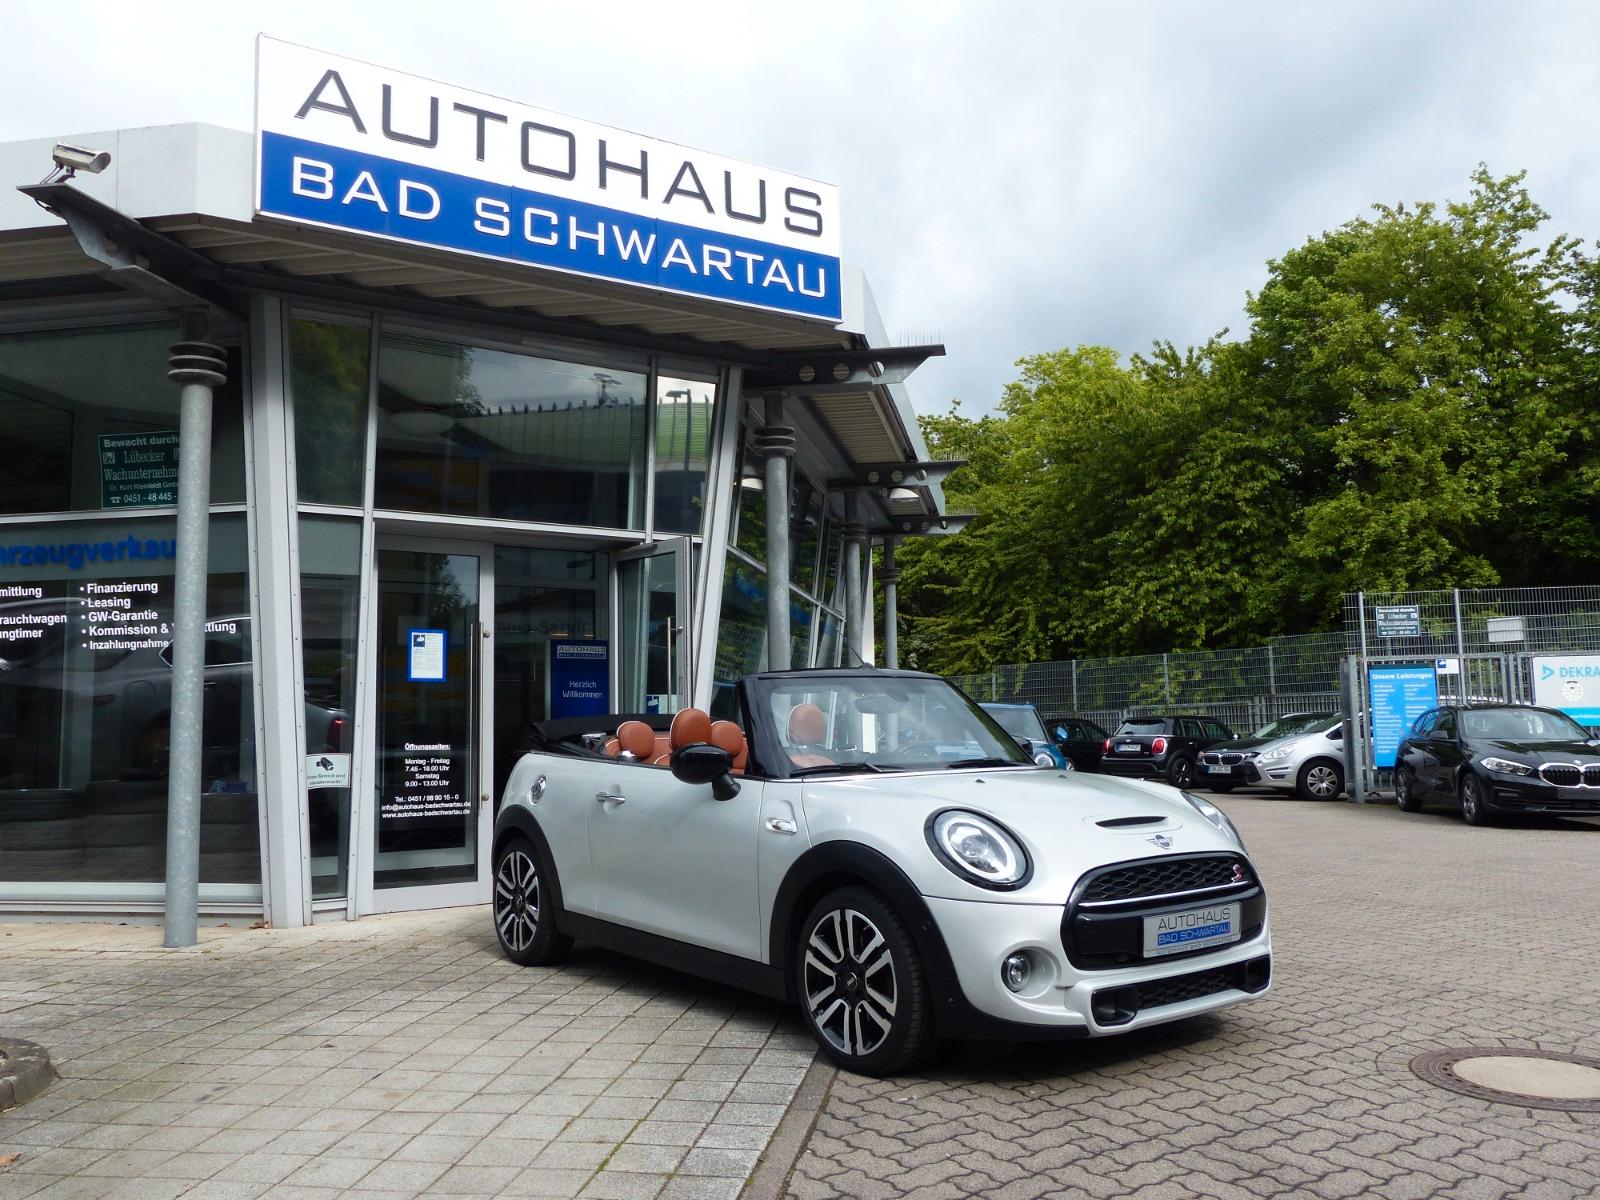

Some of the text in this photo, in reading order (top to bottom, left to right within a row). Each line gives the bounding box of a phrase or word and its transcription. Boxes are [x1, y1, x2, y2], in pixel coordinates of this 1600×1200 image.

[294, 69, 823, 238] AUTOHAUS
[292, 156, 826, 298] BAD SCHWARTAU
[104, 435, 179, 448] Bewacht durch
[123, 450, 165, 464] Lübecker
[104, 466, 178, 481] Wachunternehm
[123, 493, 141, 503] 0451
[147, 492, 157, 501] 48
[158, 492, 172, 501] 445
[0, 534, 177, 570] rzeugverkau
[87, 582, 159, 594] Finanzierung
[88, 597, 131, 609] Leasing
[88, 609, 158, 622] GW-Garantie
[0, 628, 43, 641] ngtimer
[89, 624, 158, 636] Kommission
[160, 623, 169, 634] &
[89, 639, 169, 650] Inzahlungnahme
[1559, 666, 1600, 678] DEKRA
[569, 680, 597, 689] Herzlich
[562, 690, 603, 699] Willkommen
[430, 757, 451, 765] Freitag
[1158, 907, 1231, 931] AUTOHAUS
[1158, 922, 1230, 944] BAD SCHWARTAU
